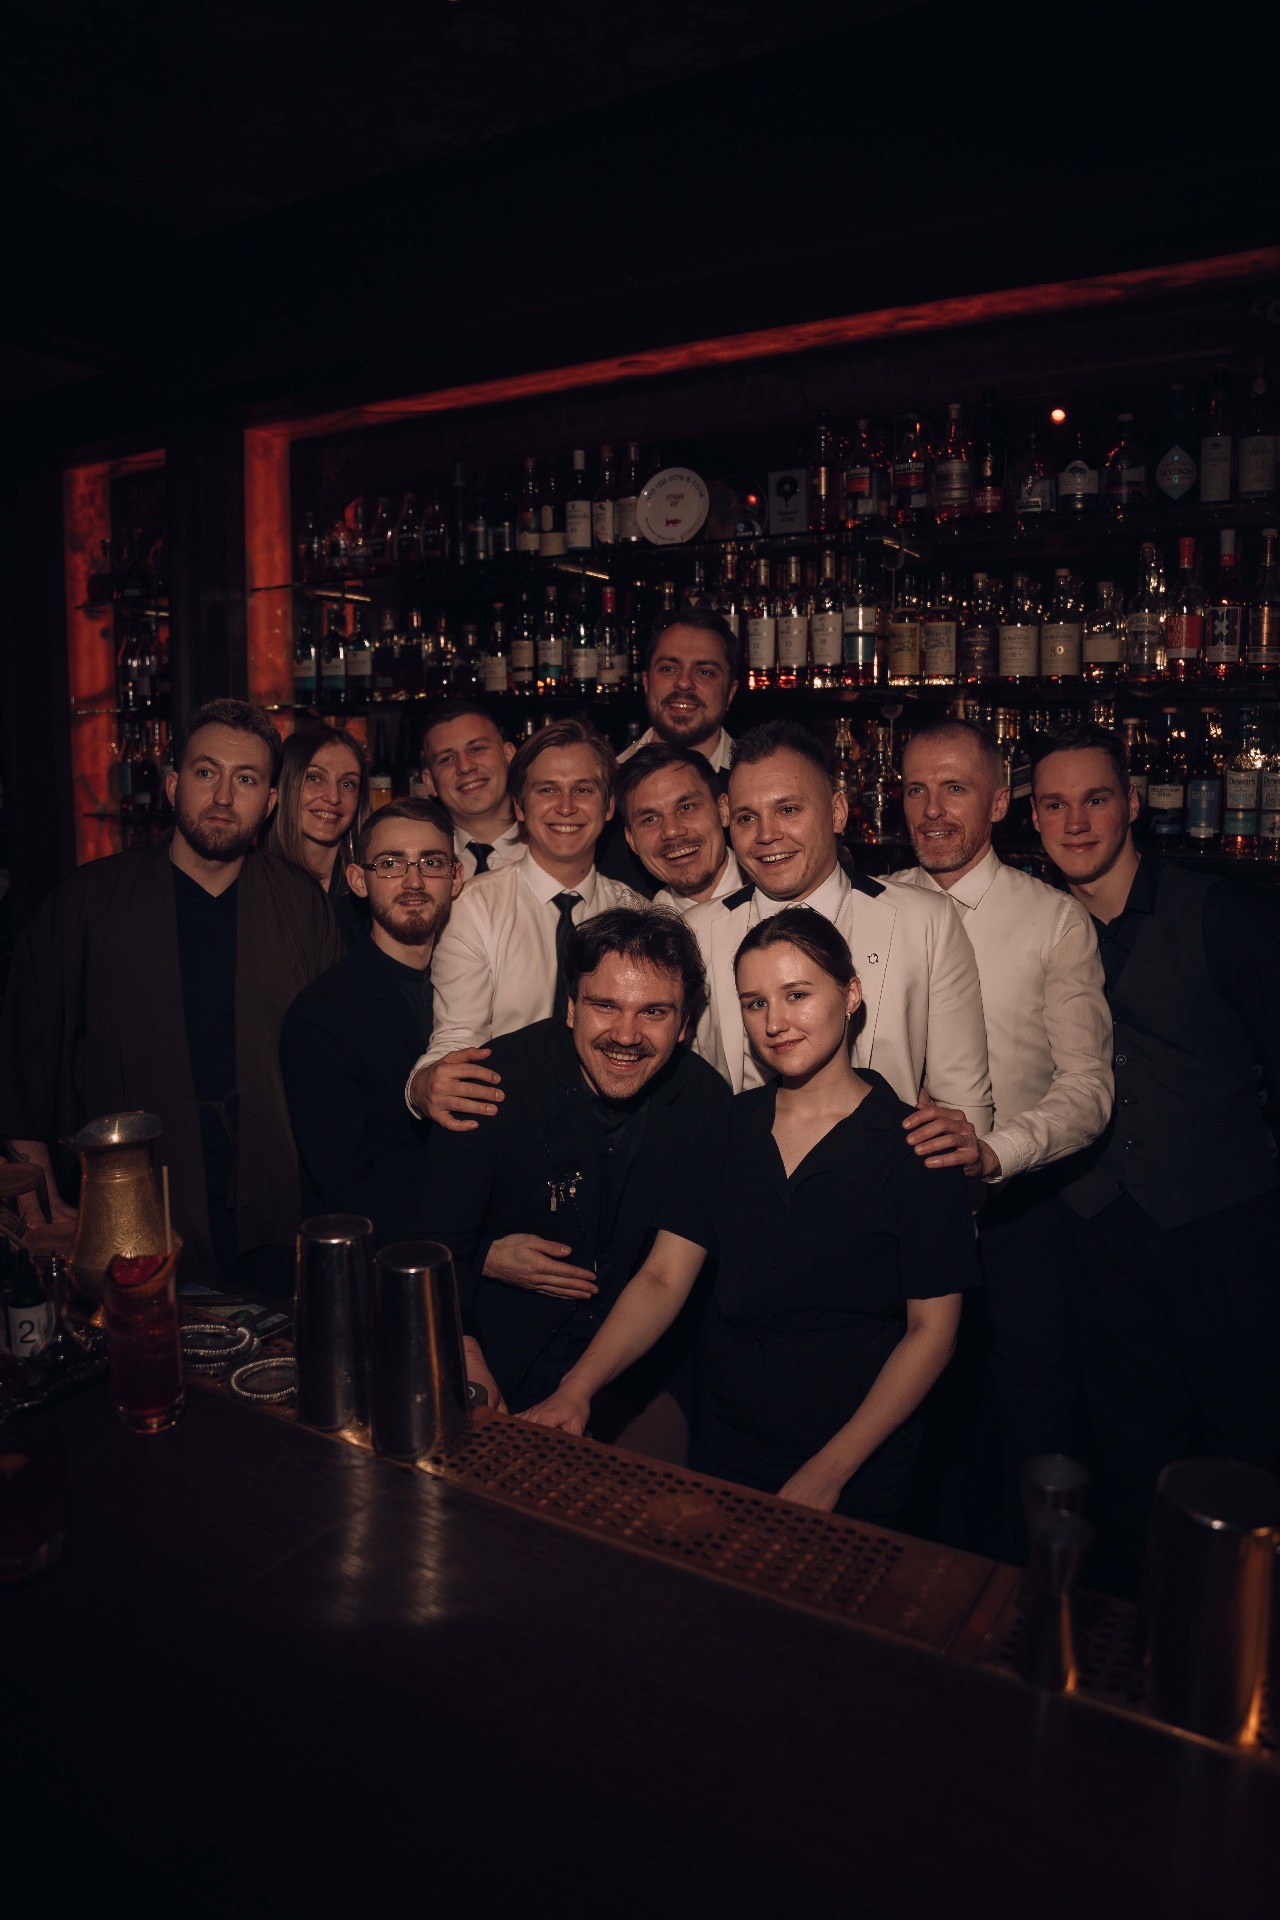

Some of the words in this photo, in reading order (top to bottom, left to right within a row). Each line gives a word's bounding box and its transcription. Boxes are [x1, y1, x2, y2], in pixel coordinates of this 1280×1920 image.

[1159, 468, 1194, 477] DEVERON
[655, 477, 668, 489] ГДЕ
[669, 474, 684, 482] ЕСТЬ
[1228, 777, 1257, 785] Dewar's
[18, 1320, 36, 1344] 2
